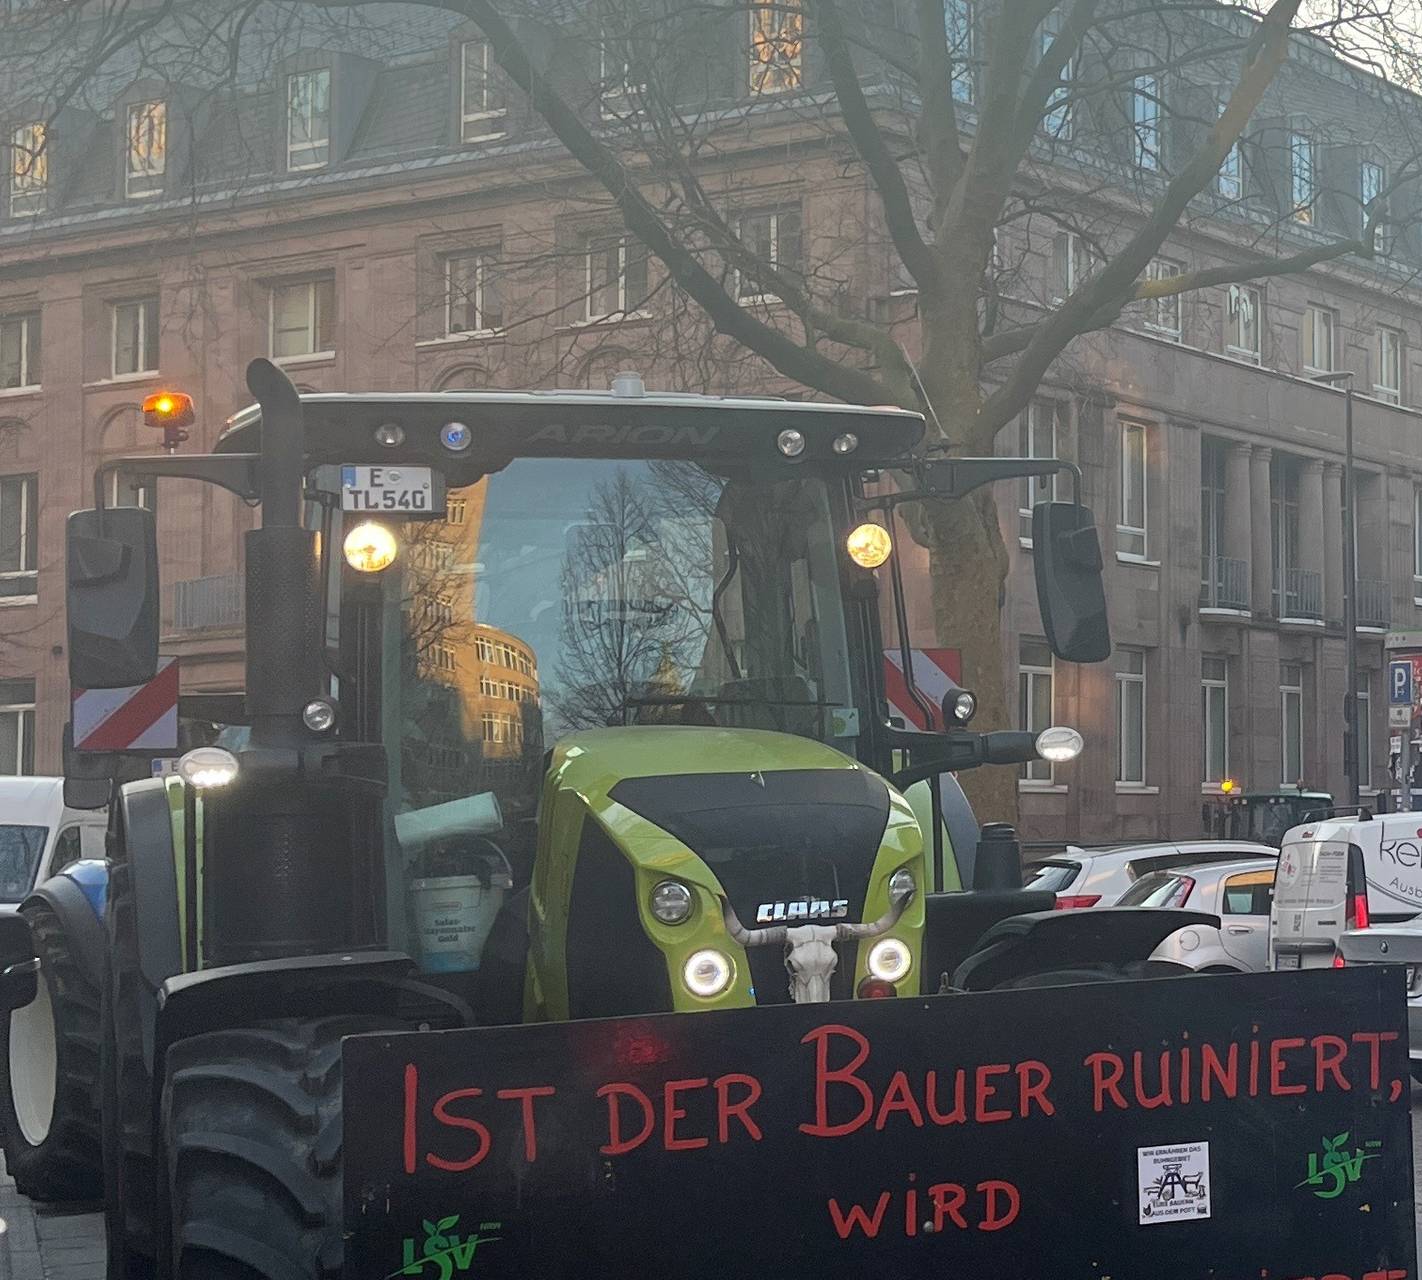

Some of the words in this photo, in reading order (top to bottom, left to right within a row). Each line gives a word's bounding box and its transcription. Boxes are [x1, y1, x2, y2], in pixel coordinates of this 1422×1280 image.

[525, 424, 720, 445] ARION
[370, 468, 384, 487] E
[1394, 667, 1407, 698] P
[757, 899, 848, 922] CLAAS
[404, 1062, 555, 1174] IST
[597, 1073, 768, 1155] DER
[799, 1024, 1055, 1137] BAUER
